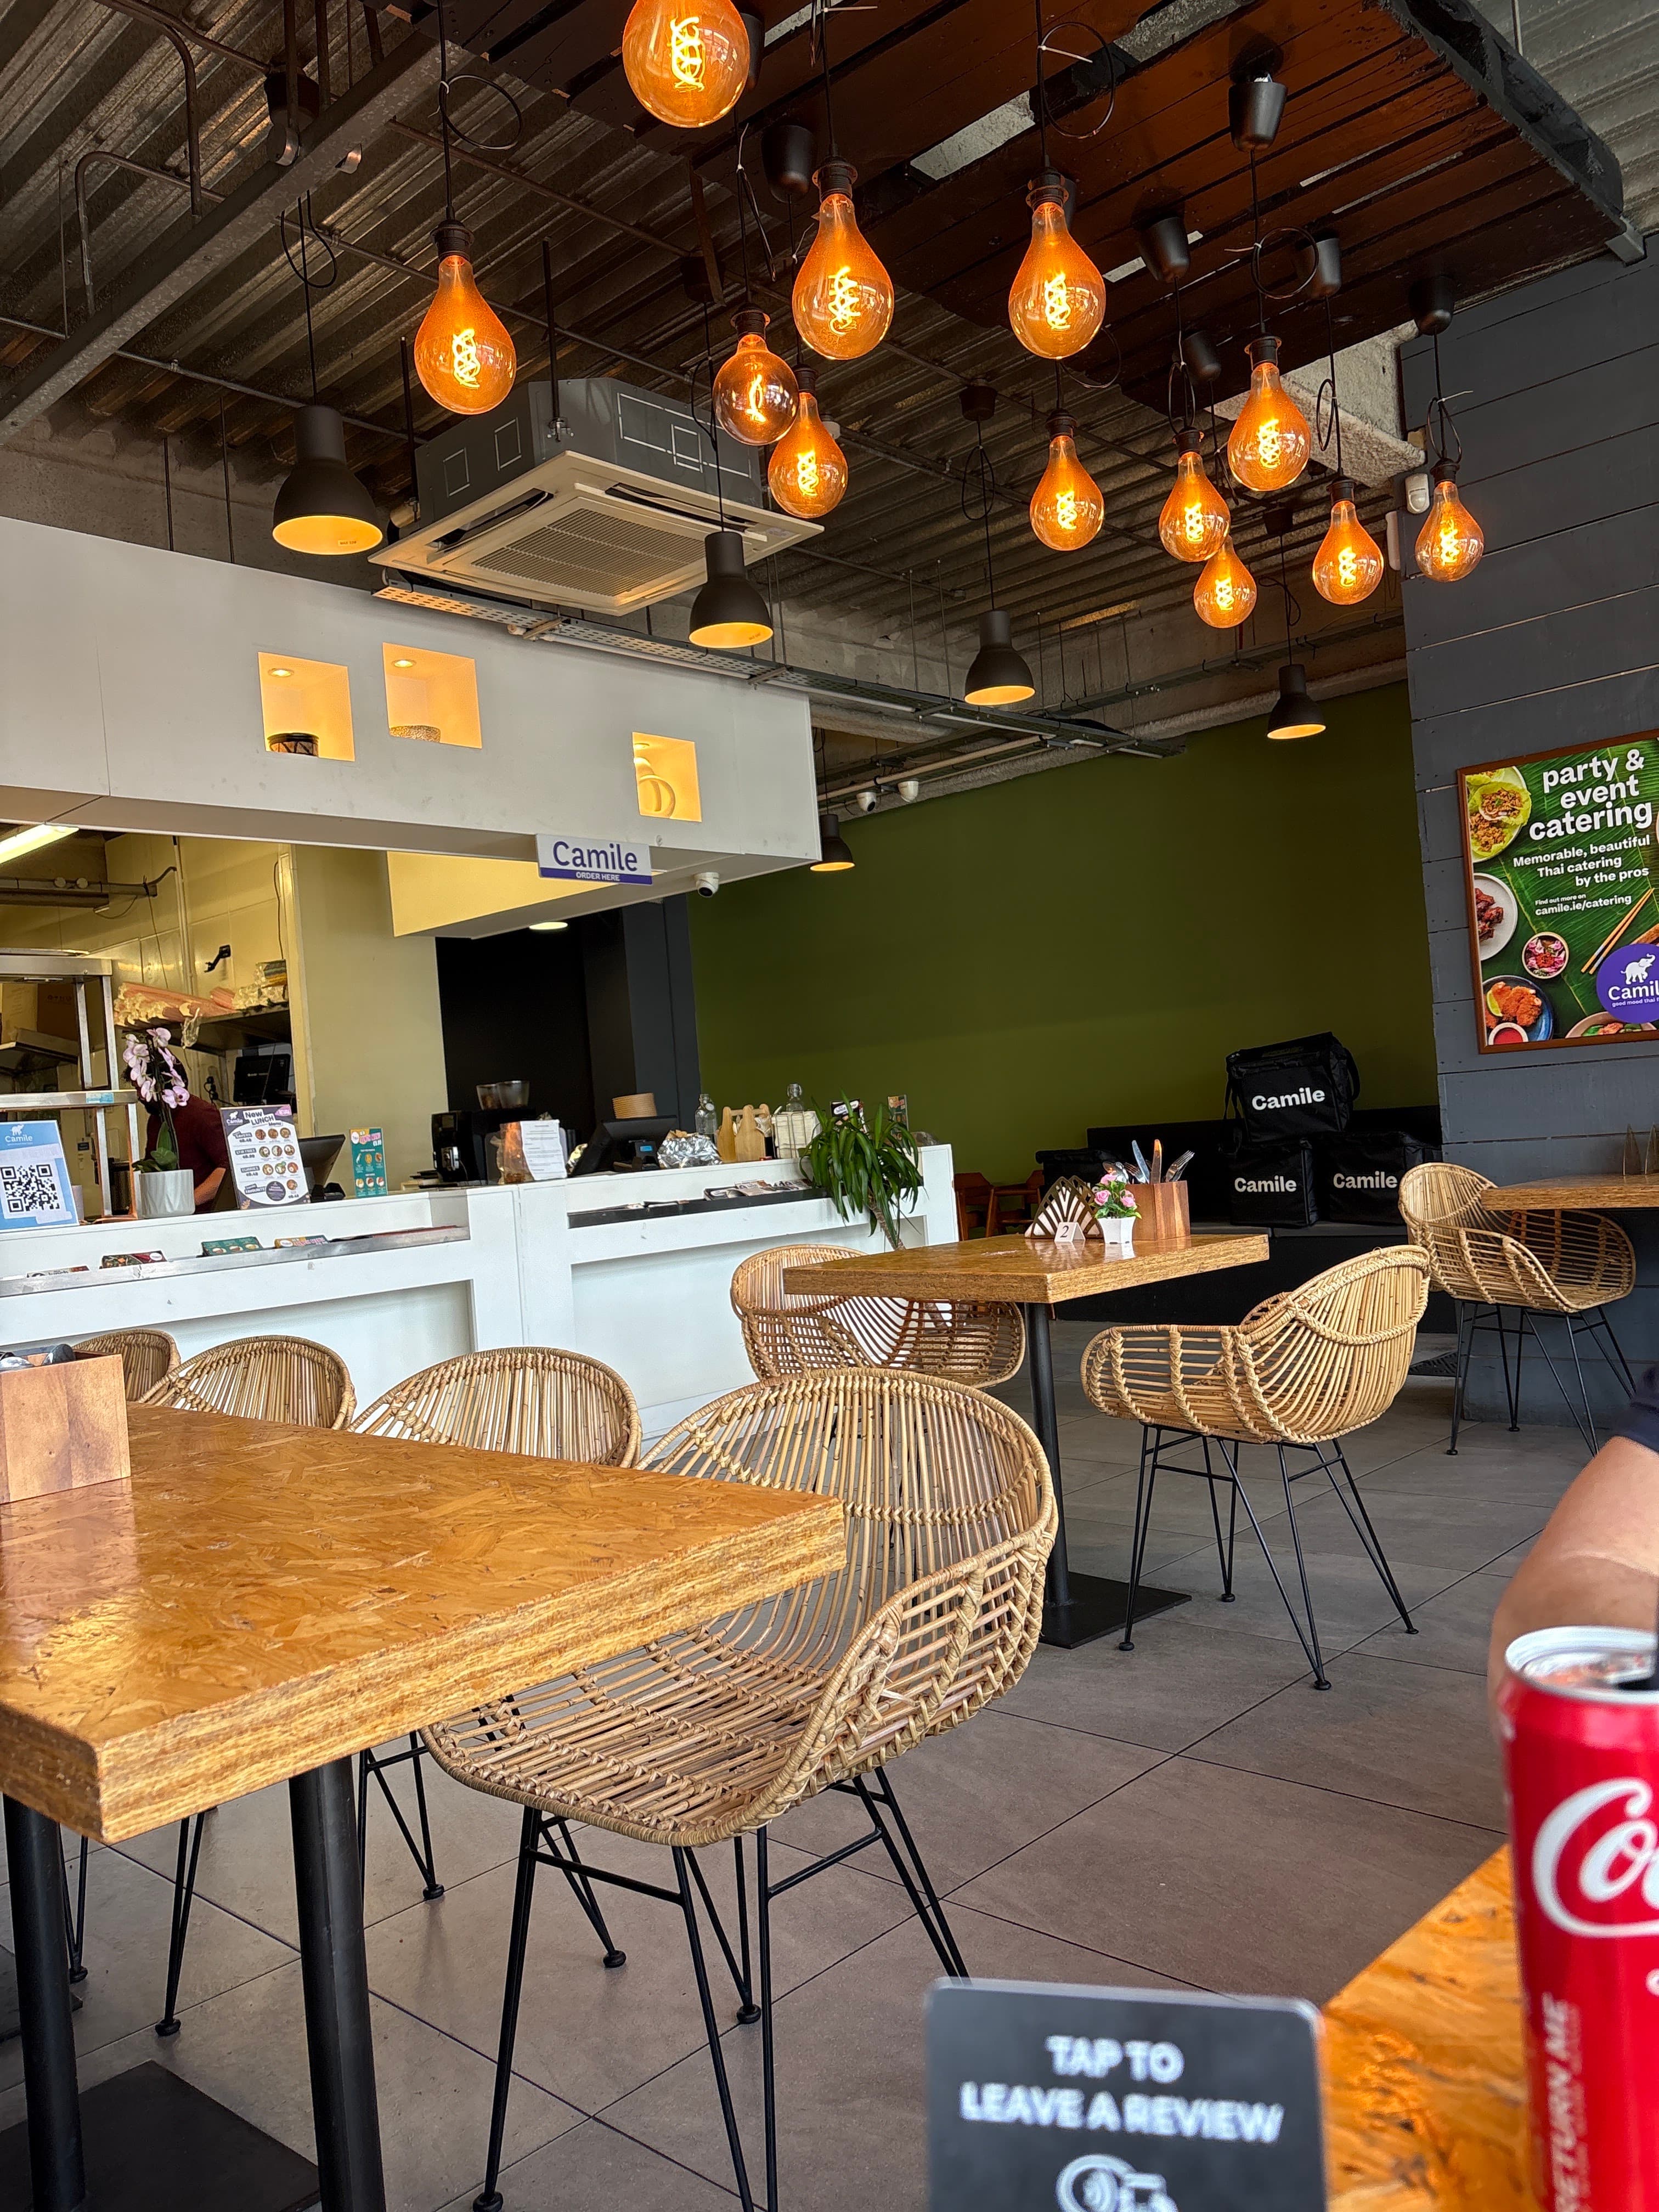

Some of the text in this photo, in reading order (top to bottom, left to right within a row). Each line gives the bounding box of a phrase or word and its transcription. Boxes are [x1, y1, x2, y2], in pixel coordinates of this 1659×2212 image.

[1543, 749, 1644, 793] party &
[1560, 774, 1639, 809] event
[1529, 802, 1652, 840] catering
[552, 840, 638, 872] Camile
[1513, 835, 1650, 867] Memorable, beautiful
[576, 872, 620, 882] ORDER HERE
[1537, 856, 1622, 878] Thai catering
[1575, 867, 1649, 887] by the pros
[1535, 895, 1632, 916] camile.ie/catering
[1608, 980, 1659, 1000] Camil
[1251, 1087, 1325, 1111] Camile
[251, 1115, 274, 1125] LUNCH
[5, 1134, 33, 1142] Camile
[1234, 1176, 1297, 1193] Camile
[1333, 1171, 1398, 1189] Camile
[1060, 1225, 1069, 1238] 2
[1044, 2033, 1186, 2084] TAP TO
[958, 2080, 1286, 2145] LEAVE A REVIEW
